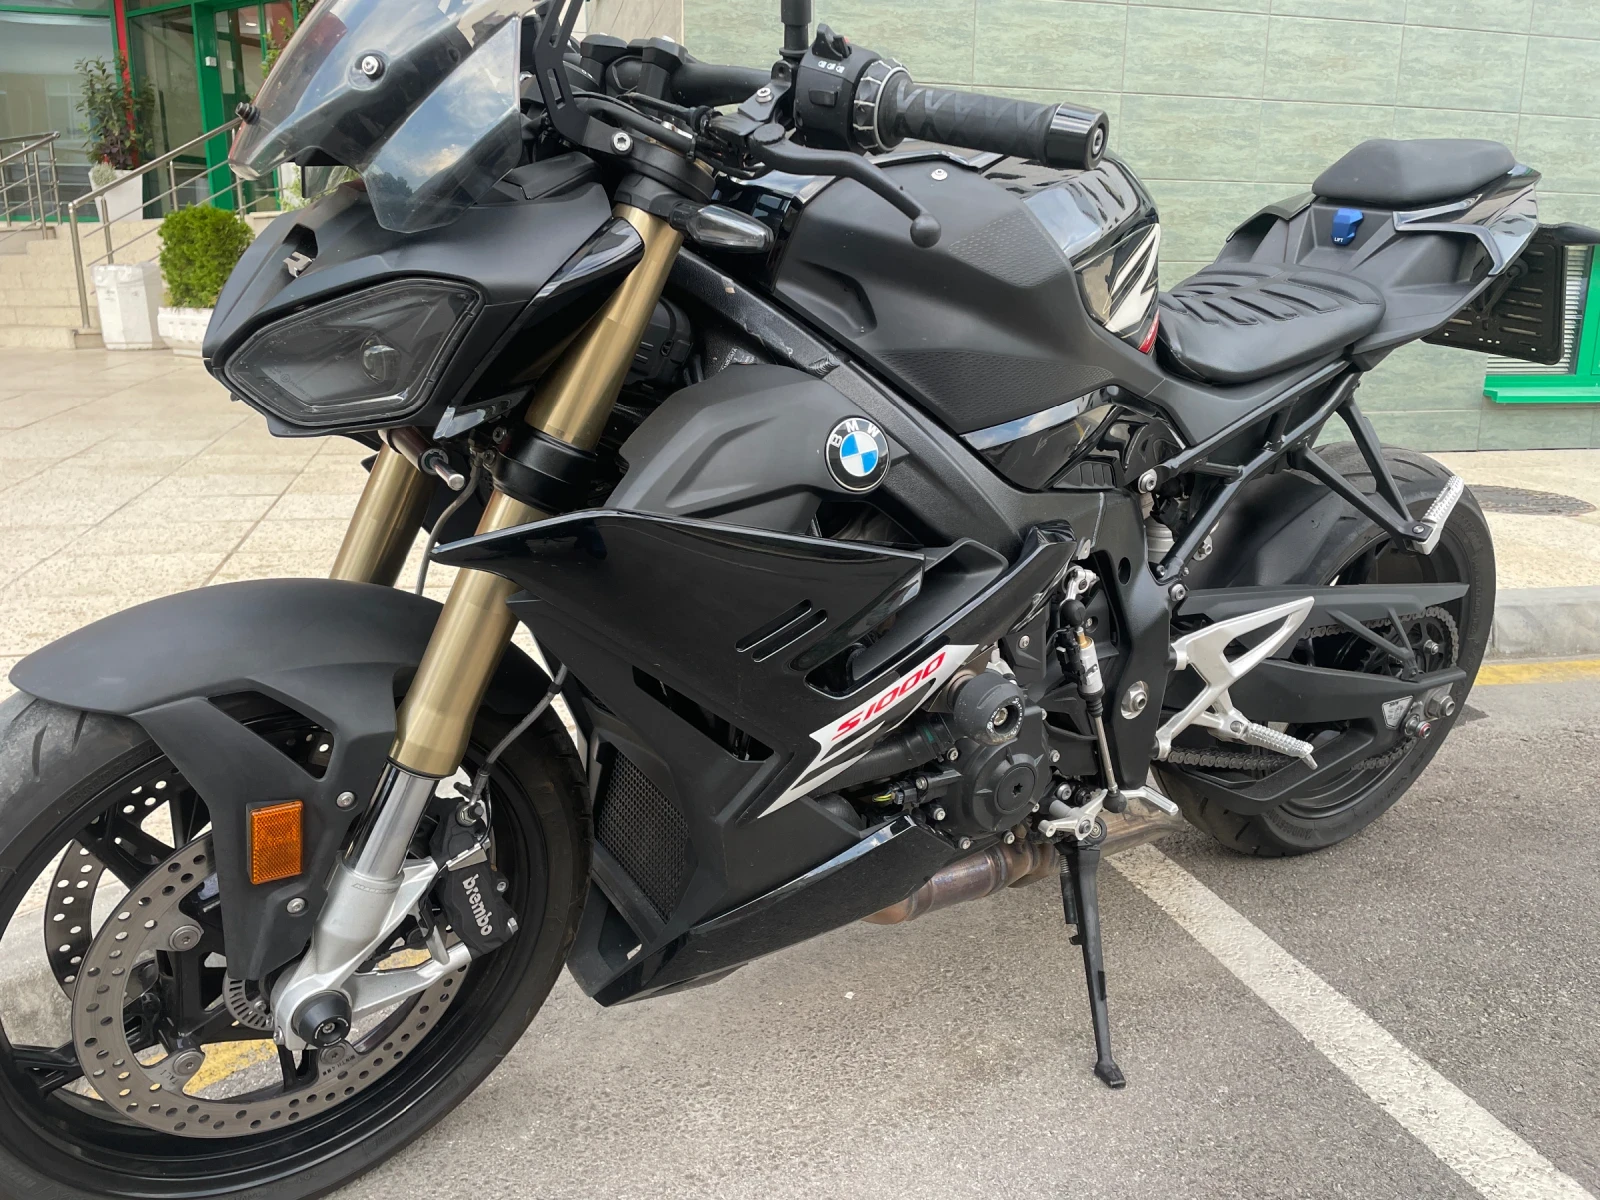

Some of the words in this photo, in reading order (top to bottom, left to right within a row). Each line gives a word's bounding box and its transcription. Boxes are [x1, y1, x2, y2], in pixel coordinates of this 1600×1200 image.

[829, 419, 880, 448] BMW
[831, 651, 946, 742] S1000
[462, 873, 493, 936] brembo
